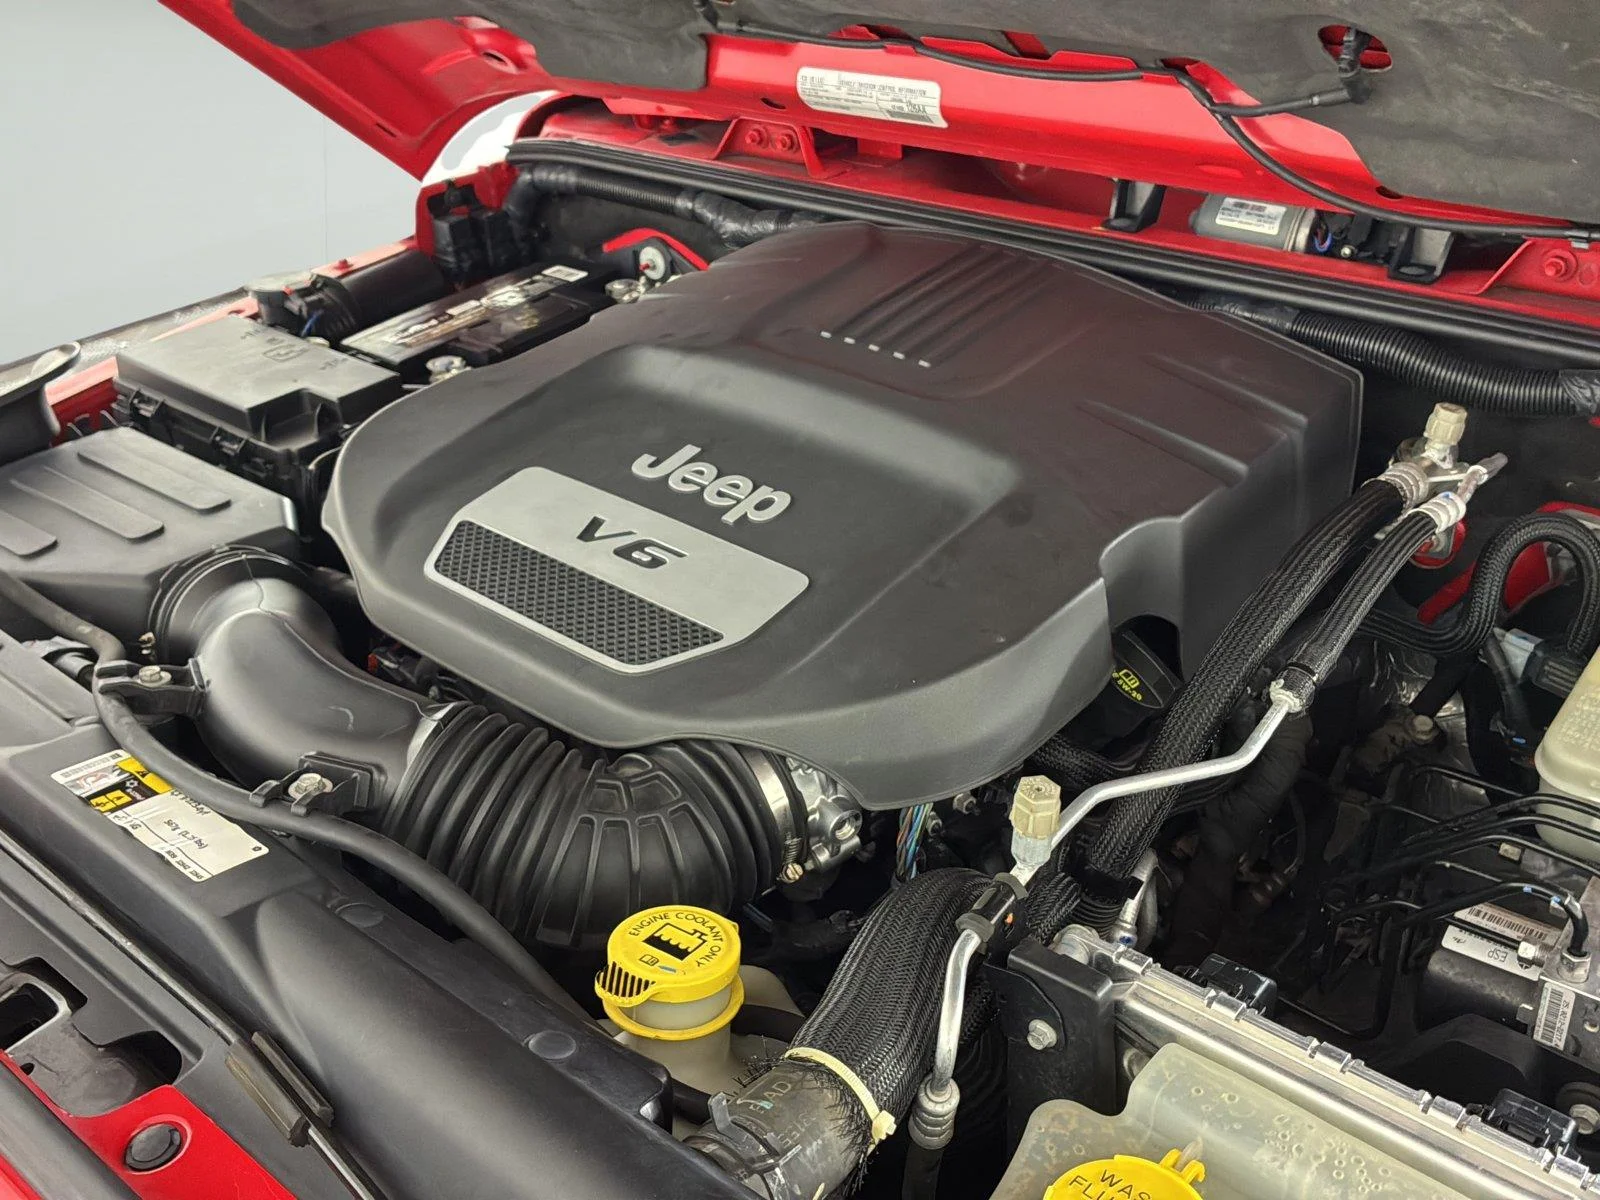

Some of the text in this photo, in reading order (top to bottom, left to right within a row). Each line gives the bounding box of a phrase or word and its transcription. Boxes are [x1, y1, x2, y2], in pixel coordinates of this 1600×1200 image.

[631, 444, 791, 525] Jeep
[576, 515, 689, 570] V6
[628, 912, 723, 967] ENGINE COOLANT ONLY
[1487, 948, 1508, 962] ESP
